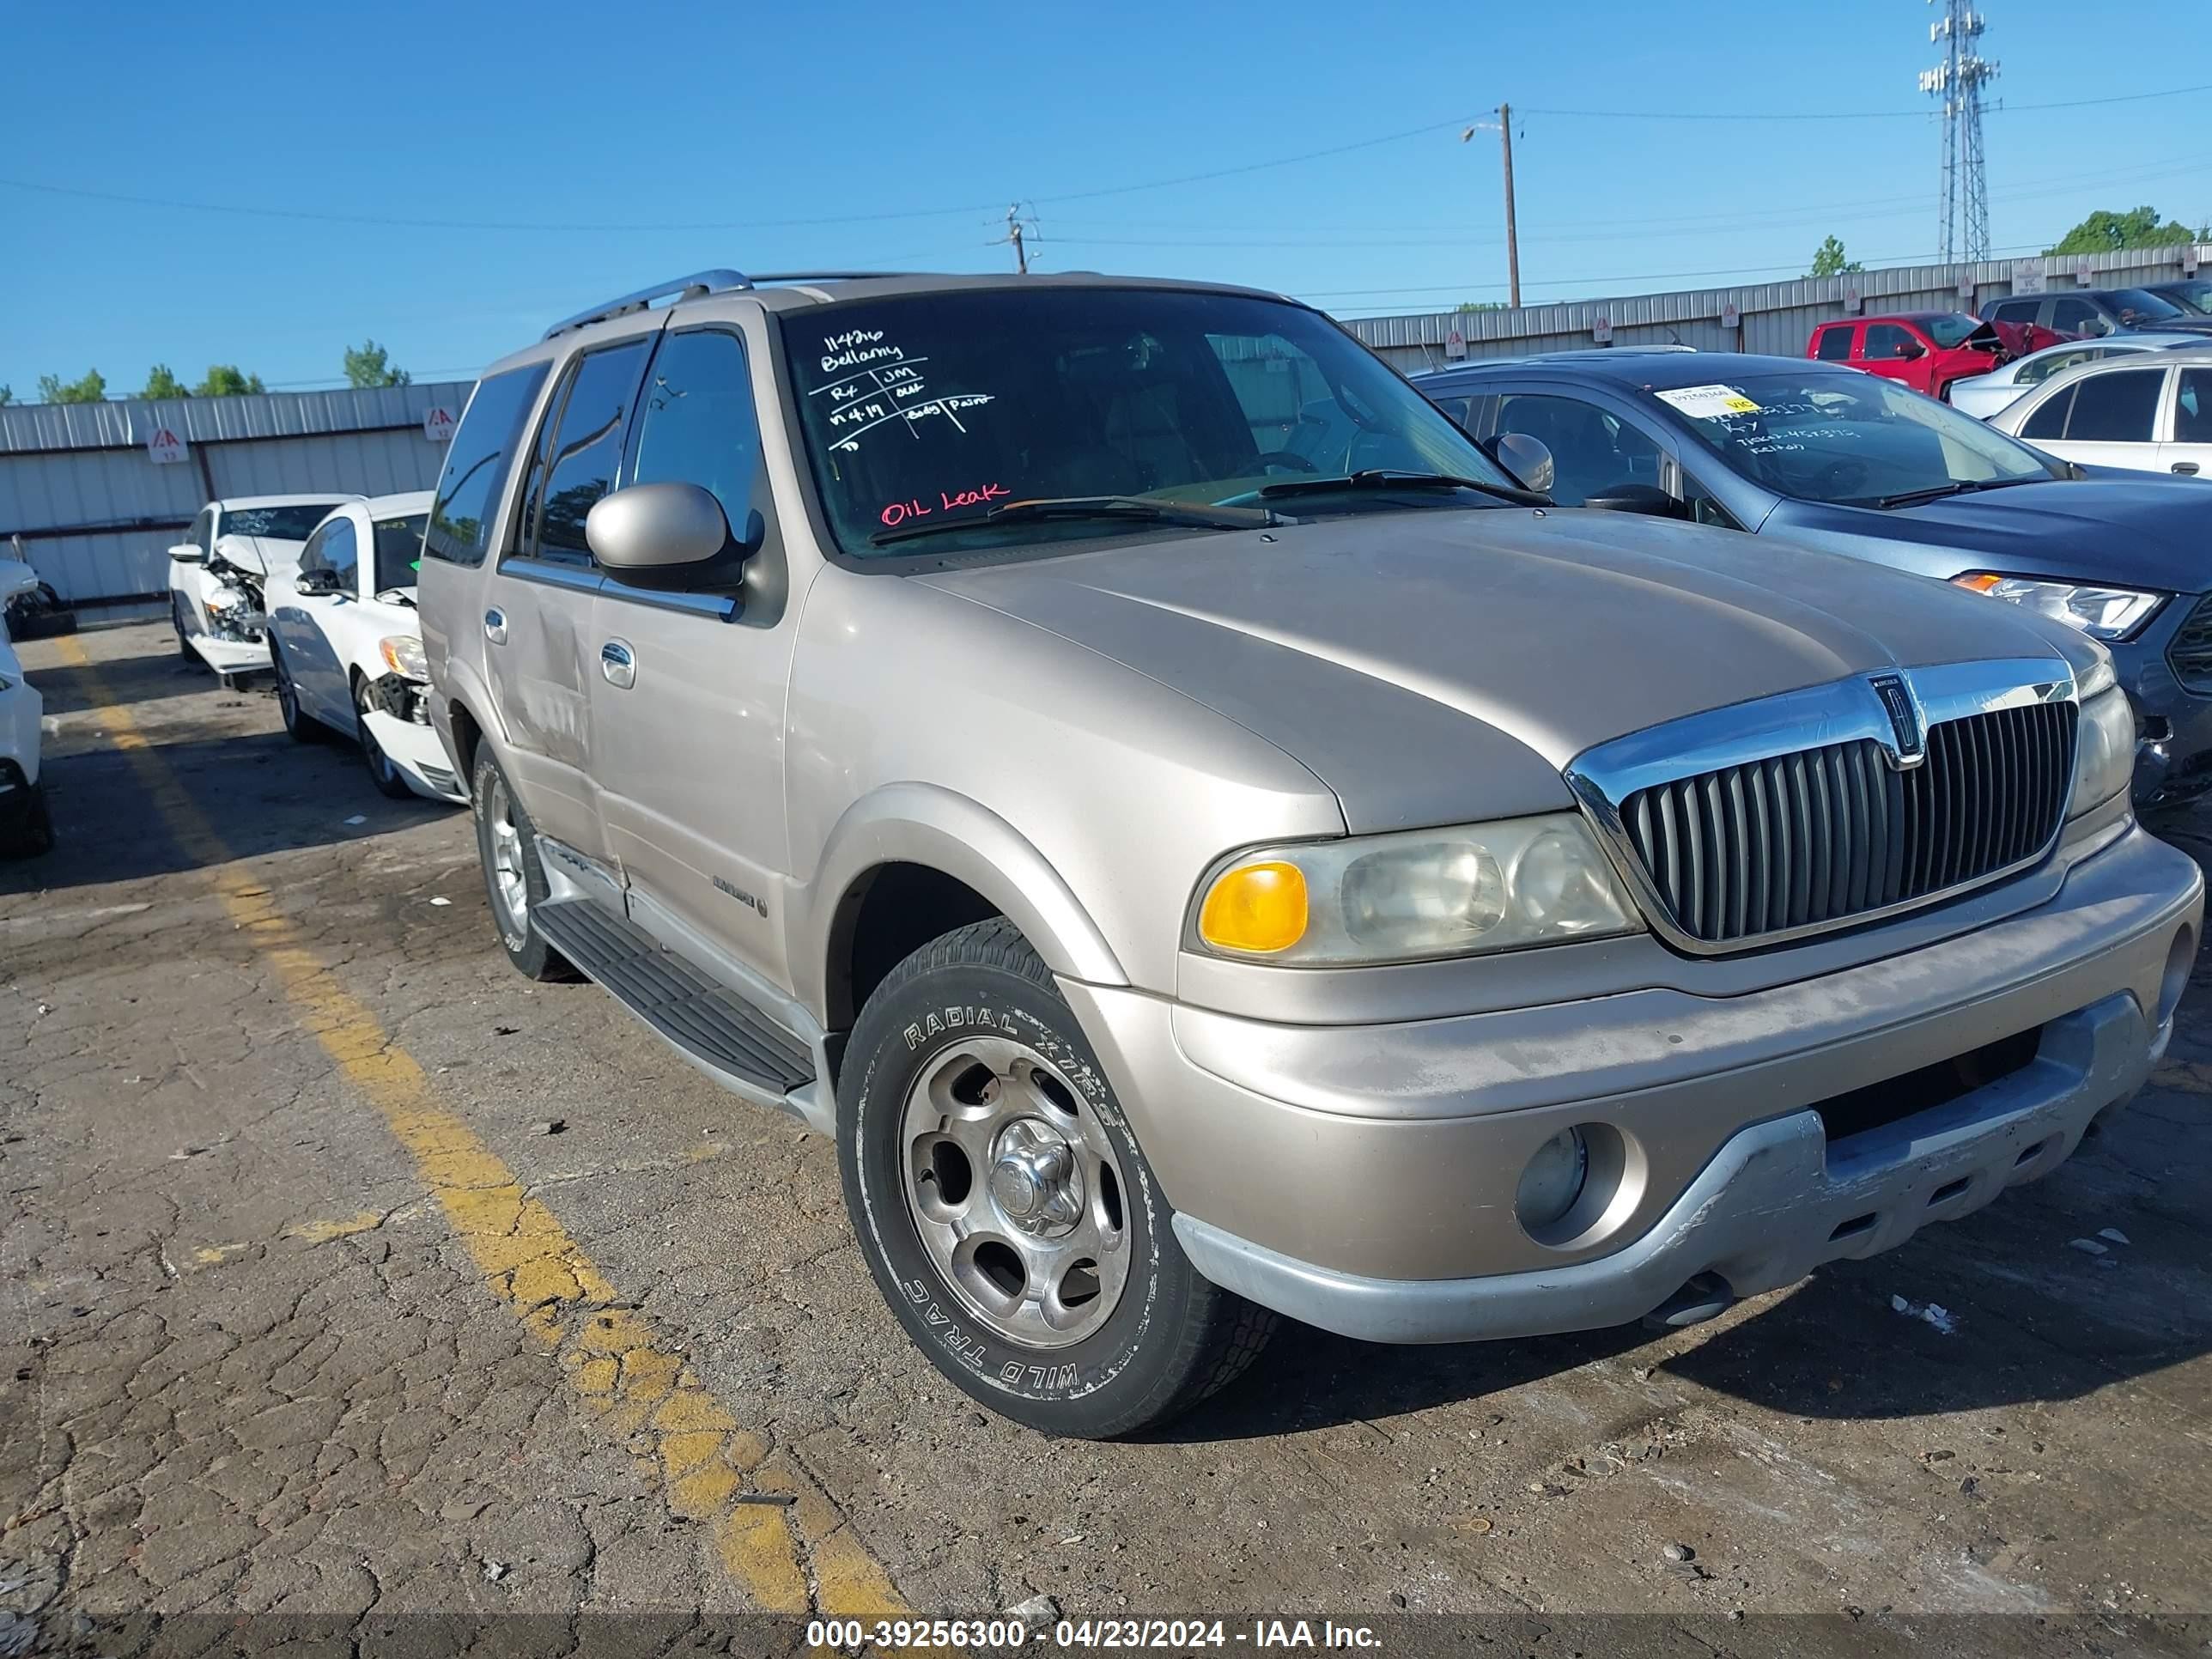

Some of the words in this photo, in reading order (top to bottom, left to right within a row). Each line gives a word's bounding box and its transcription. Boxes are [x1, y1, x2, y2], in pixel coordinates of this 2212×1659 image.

[821, 346, 904, 373] Bellamy
[902, 1006, 1019, 1052] RADIAL
[901, 1279, 989, 1369] TRAC
[999, 1359, 1080, 1392] WILD
